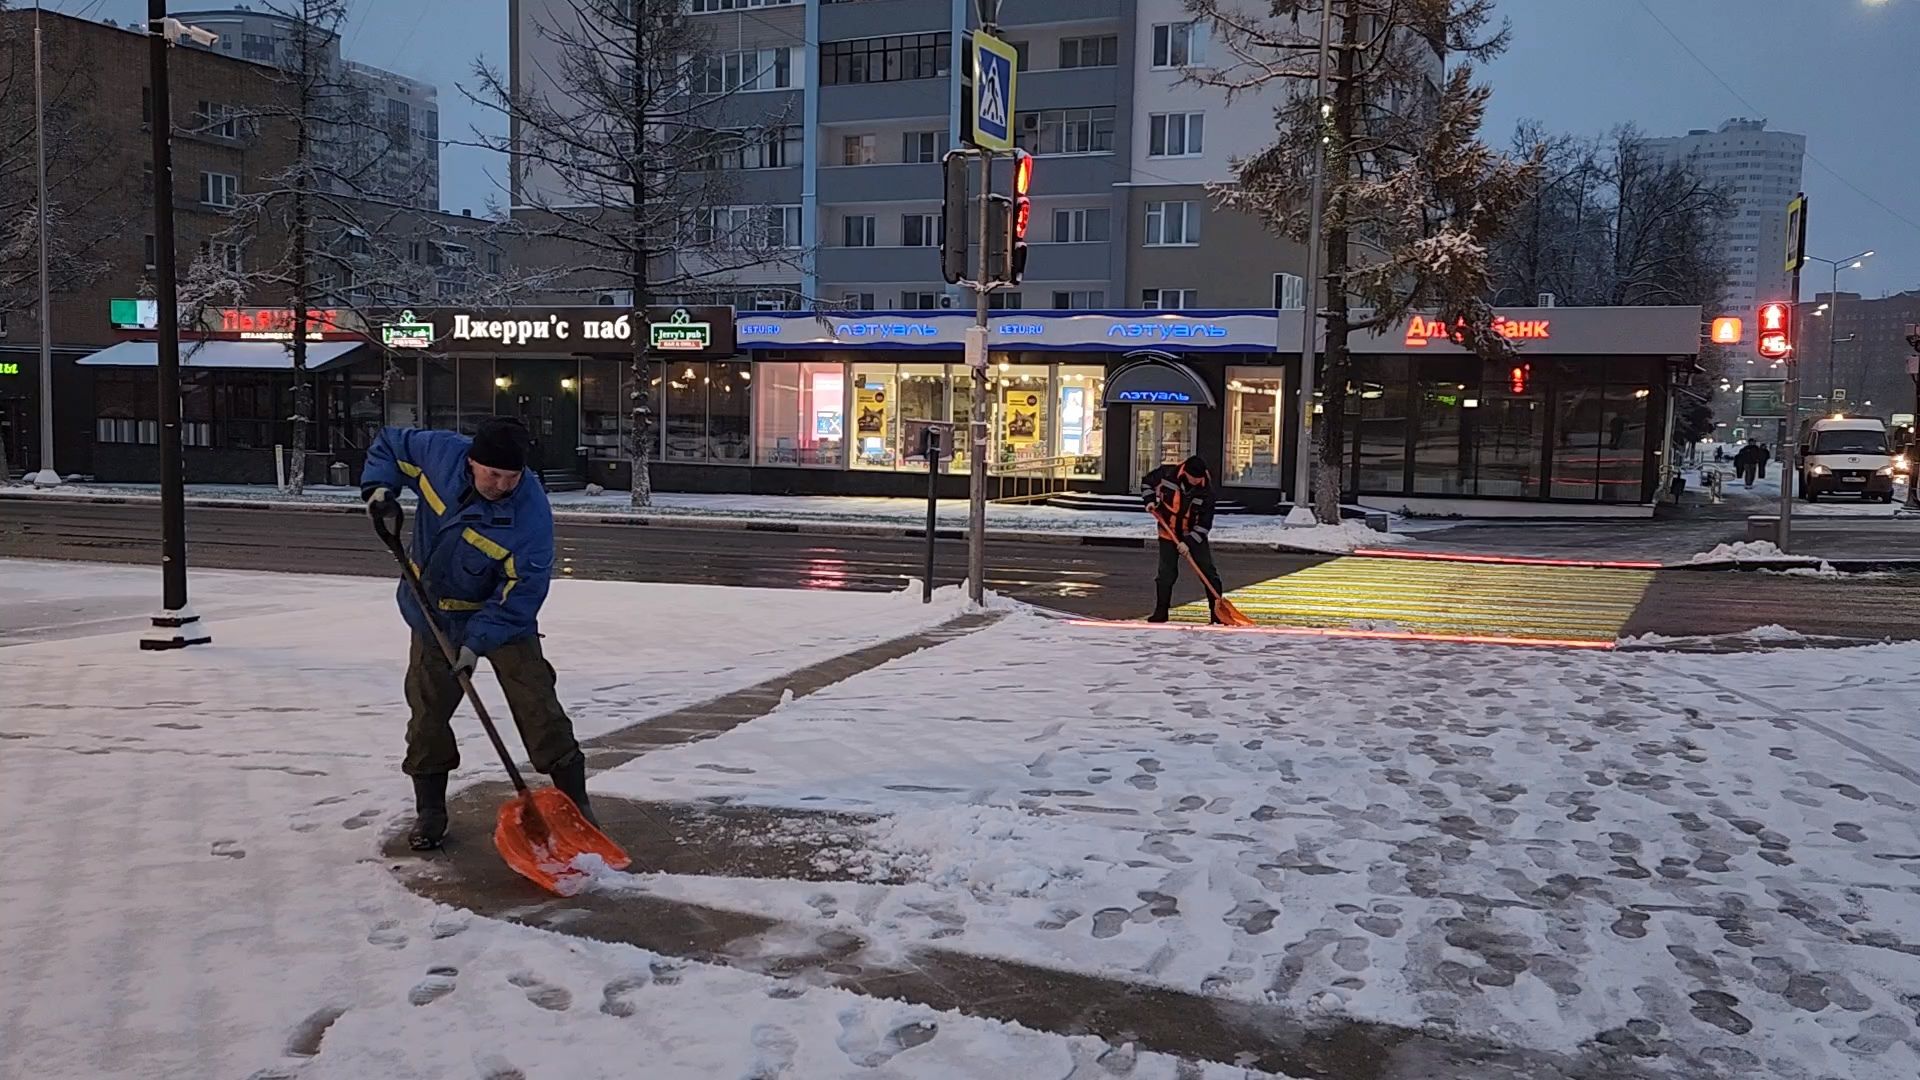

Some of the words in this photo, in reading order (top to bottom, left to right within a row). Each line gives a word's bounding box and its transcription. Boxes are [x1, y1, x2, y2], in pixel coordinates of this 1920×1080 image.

[453, 314, 569, 344] Джерри'с
[583, 315, 631, 339] паб
[658, 329, 685, 340] Jerry's
[686, 329, 702, 340] pub
[999, 325, 1043, 334] LETU.RU
